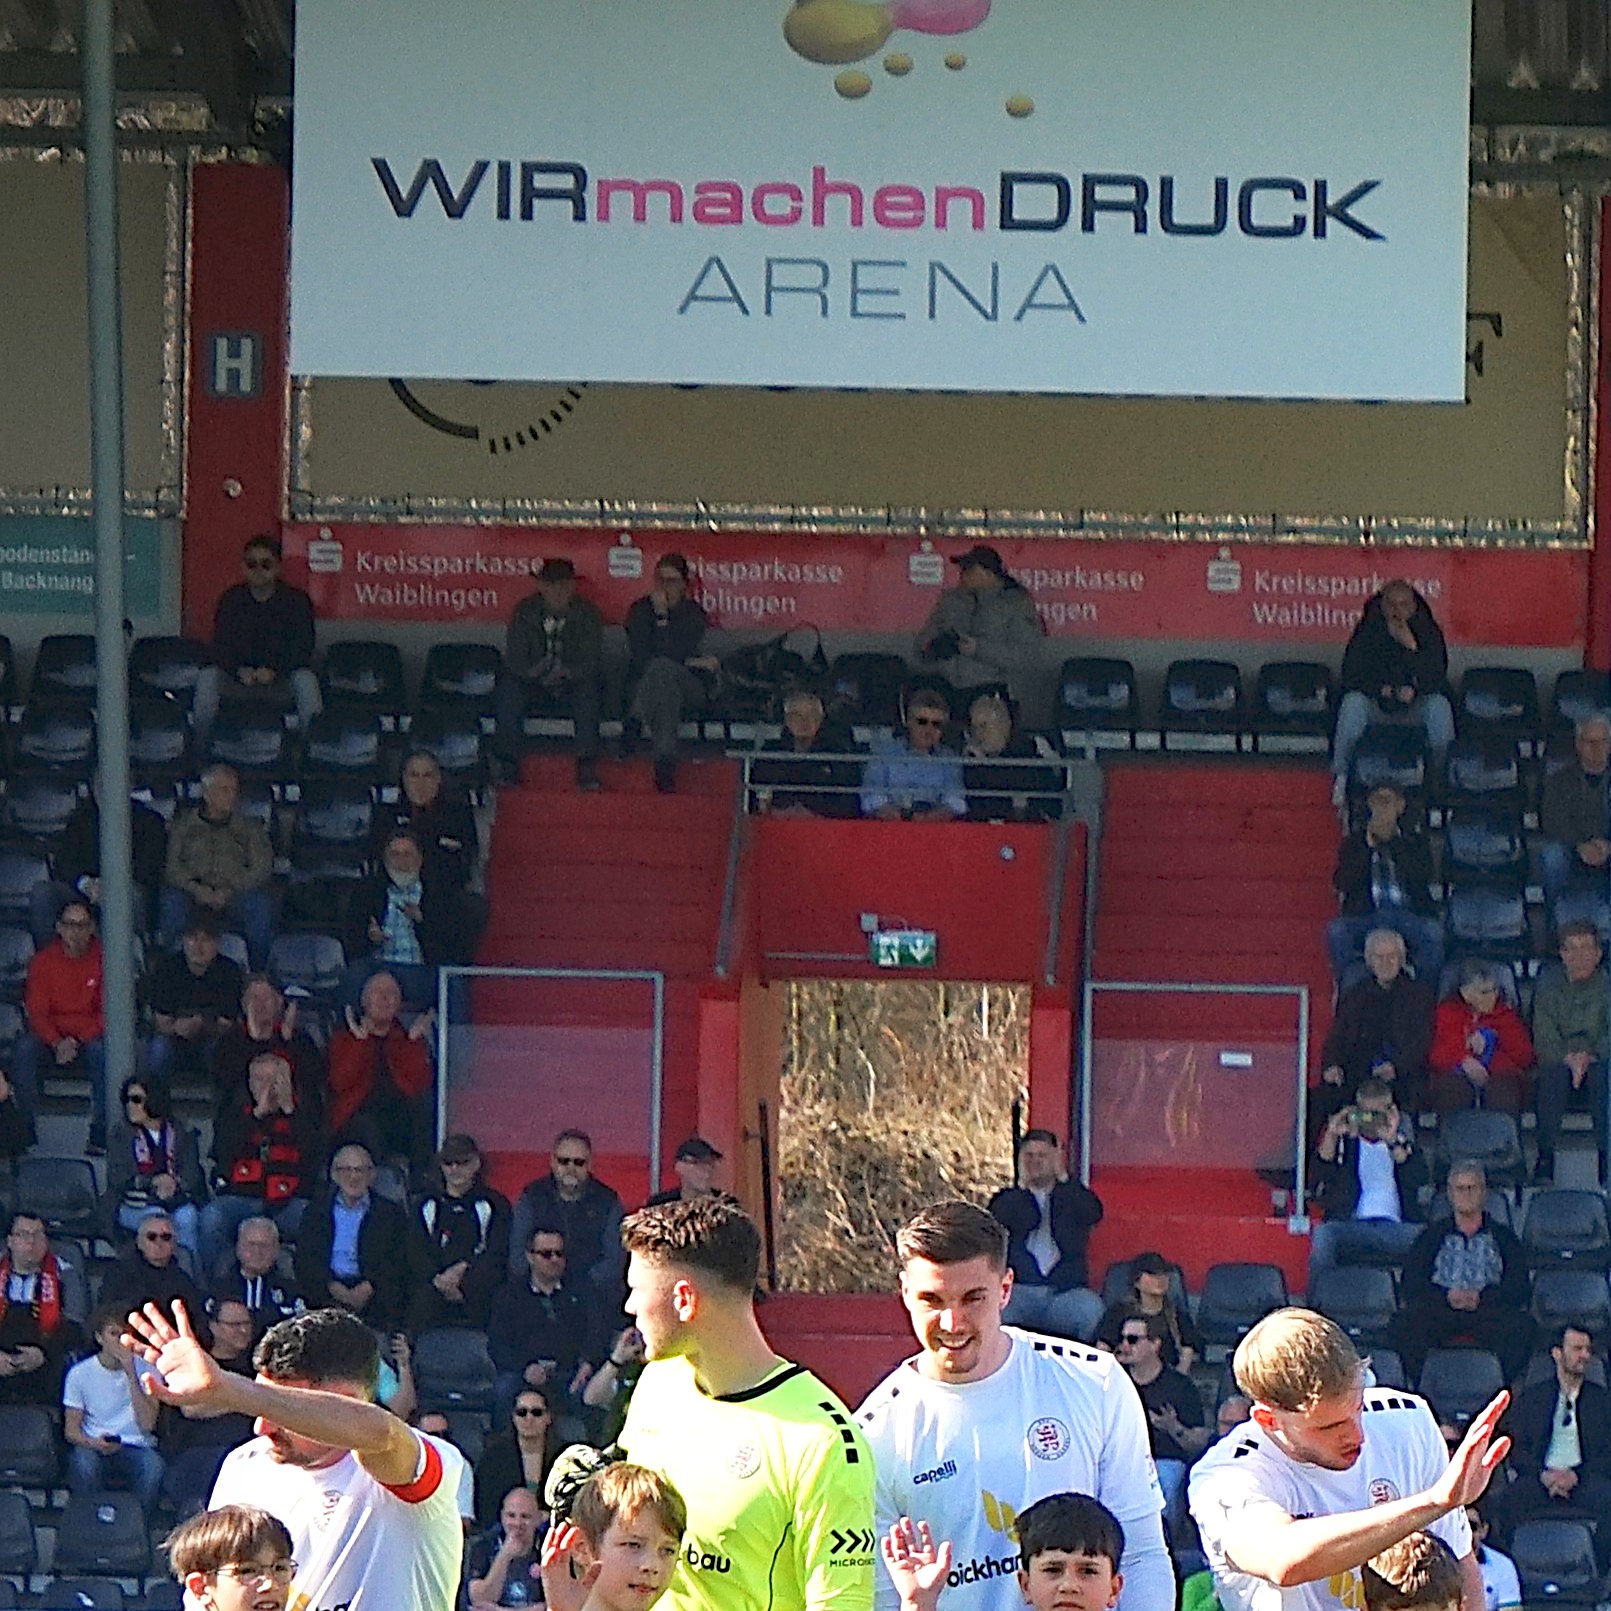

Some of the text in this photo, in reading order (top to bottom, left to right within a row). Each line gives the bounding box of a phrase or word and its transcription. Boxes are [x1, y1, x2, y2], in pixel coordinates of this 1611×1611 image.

[370, 155, 1388, 241] WIRmachenDRUCK
[677, 253, 1089, 324] ARENA
[213, 332, 254, 394] H
[356, 549, 544, 577] Kreissparkasse
[355, 583, 499, 609] Waiblingen
[913, 1459, 957, 1485] capelli
[687, 1543, 731, 1574] bau
